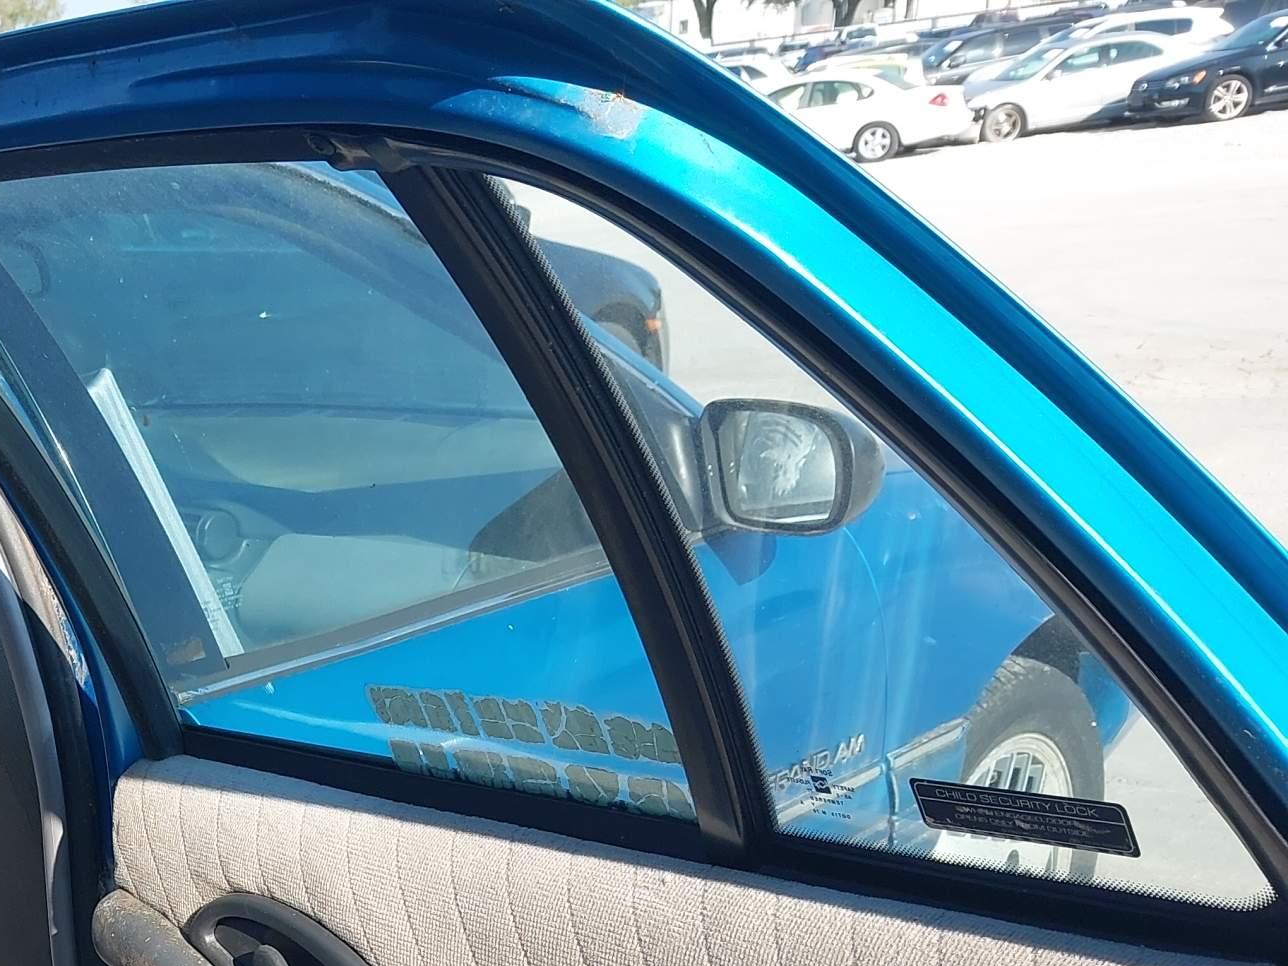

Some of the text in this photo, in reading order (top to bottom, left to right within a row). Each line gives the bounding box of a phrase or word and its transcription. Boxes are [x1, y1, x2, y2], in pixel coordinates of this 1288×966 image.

[833, 732, 865, 764] AM
[935, 788, 1098, 818] CHILD SECURITY LOCK
